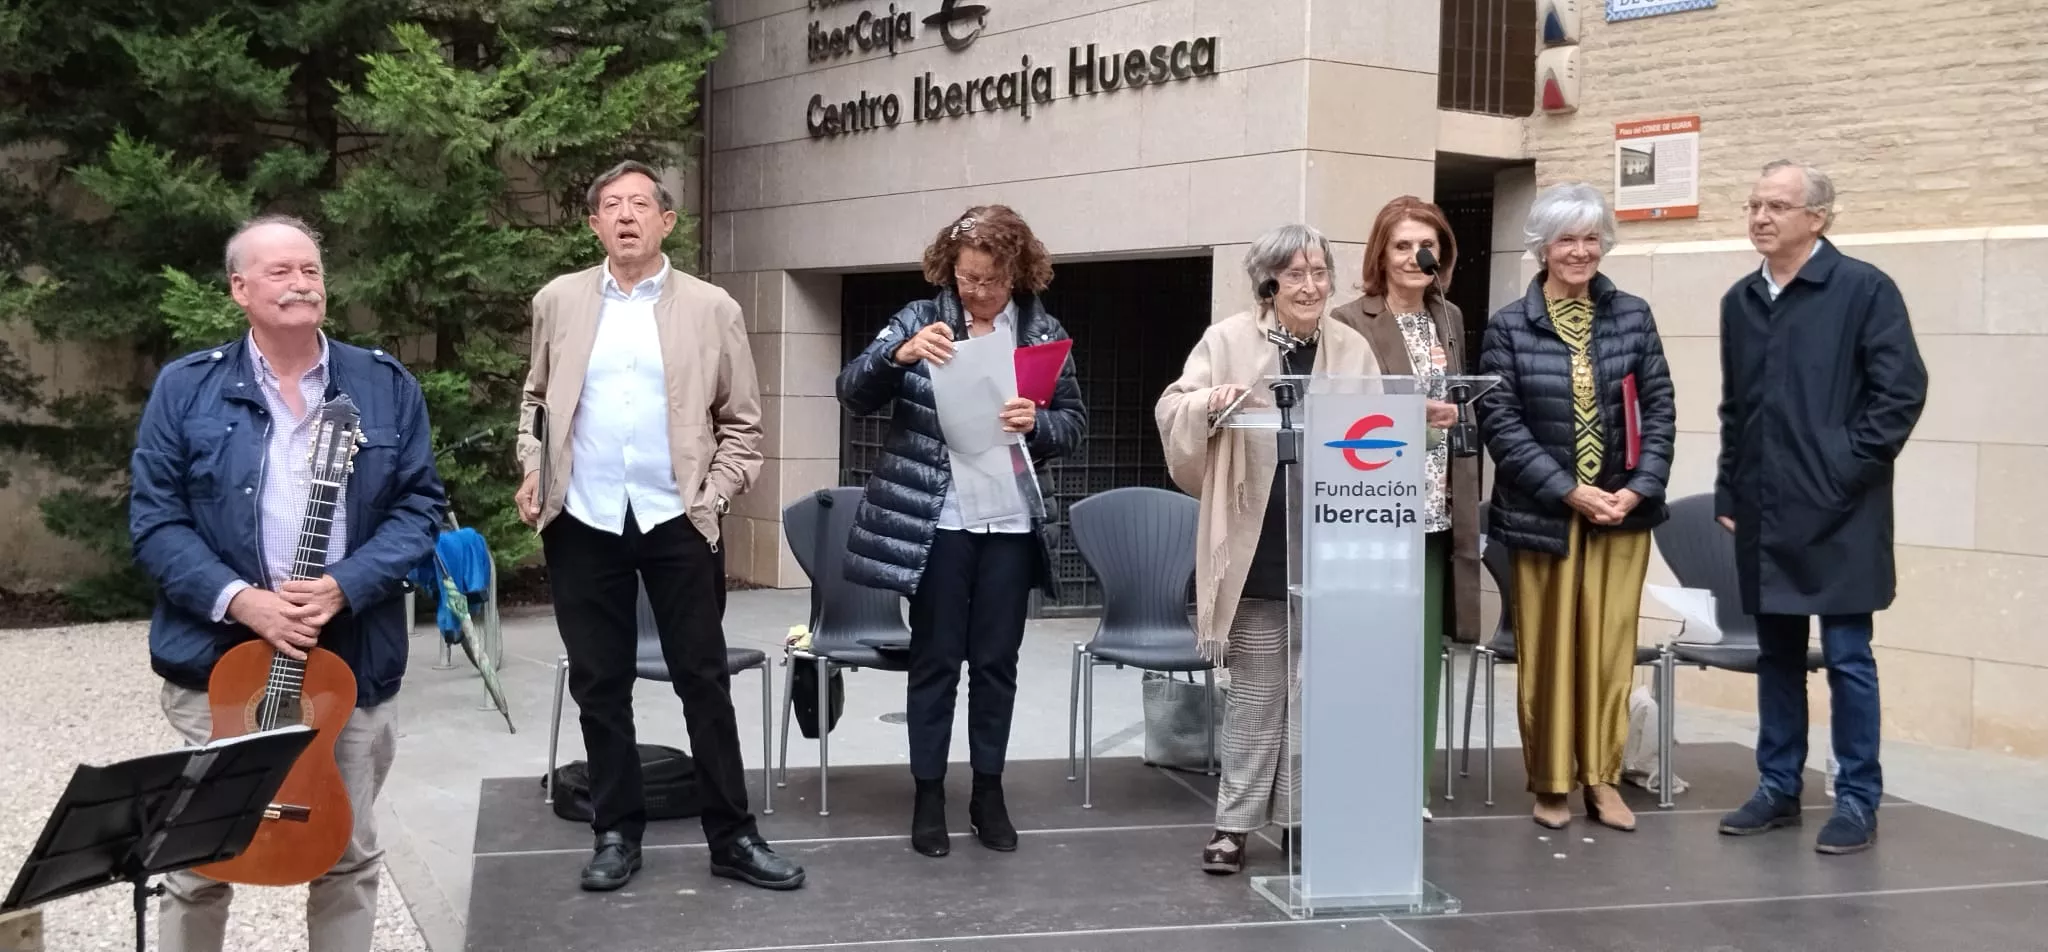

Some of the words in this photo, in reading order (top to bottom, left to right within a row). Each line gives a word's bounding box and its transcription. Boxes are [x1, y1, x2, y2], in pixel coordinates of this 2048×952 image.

[807, 91, 900, 137] Centro
[914, 54, 1056, 121] Ibercaja
[1068, 36, 1221, 97] Huesca
[1315, 481, 1417, 497] Fundación
[1315, 502, 1417, 528] Ibercaja
